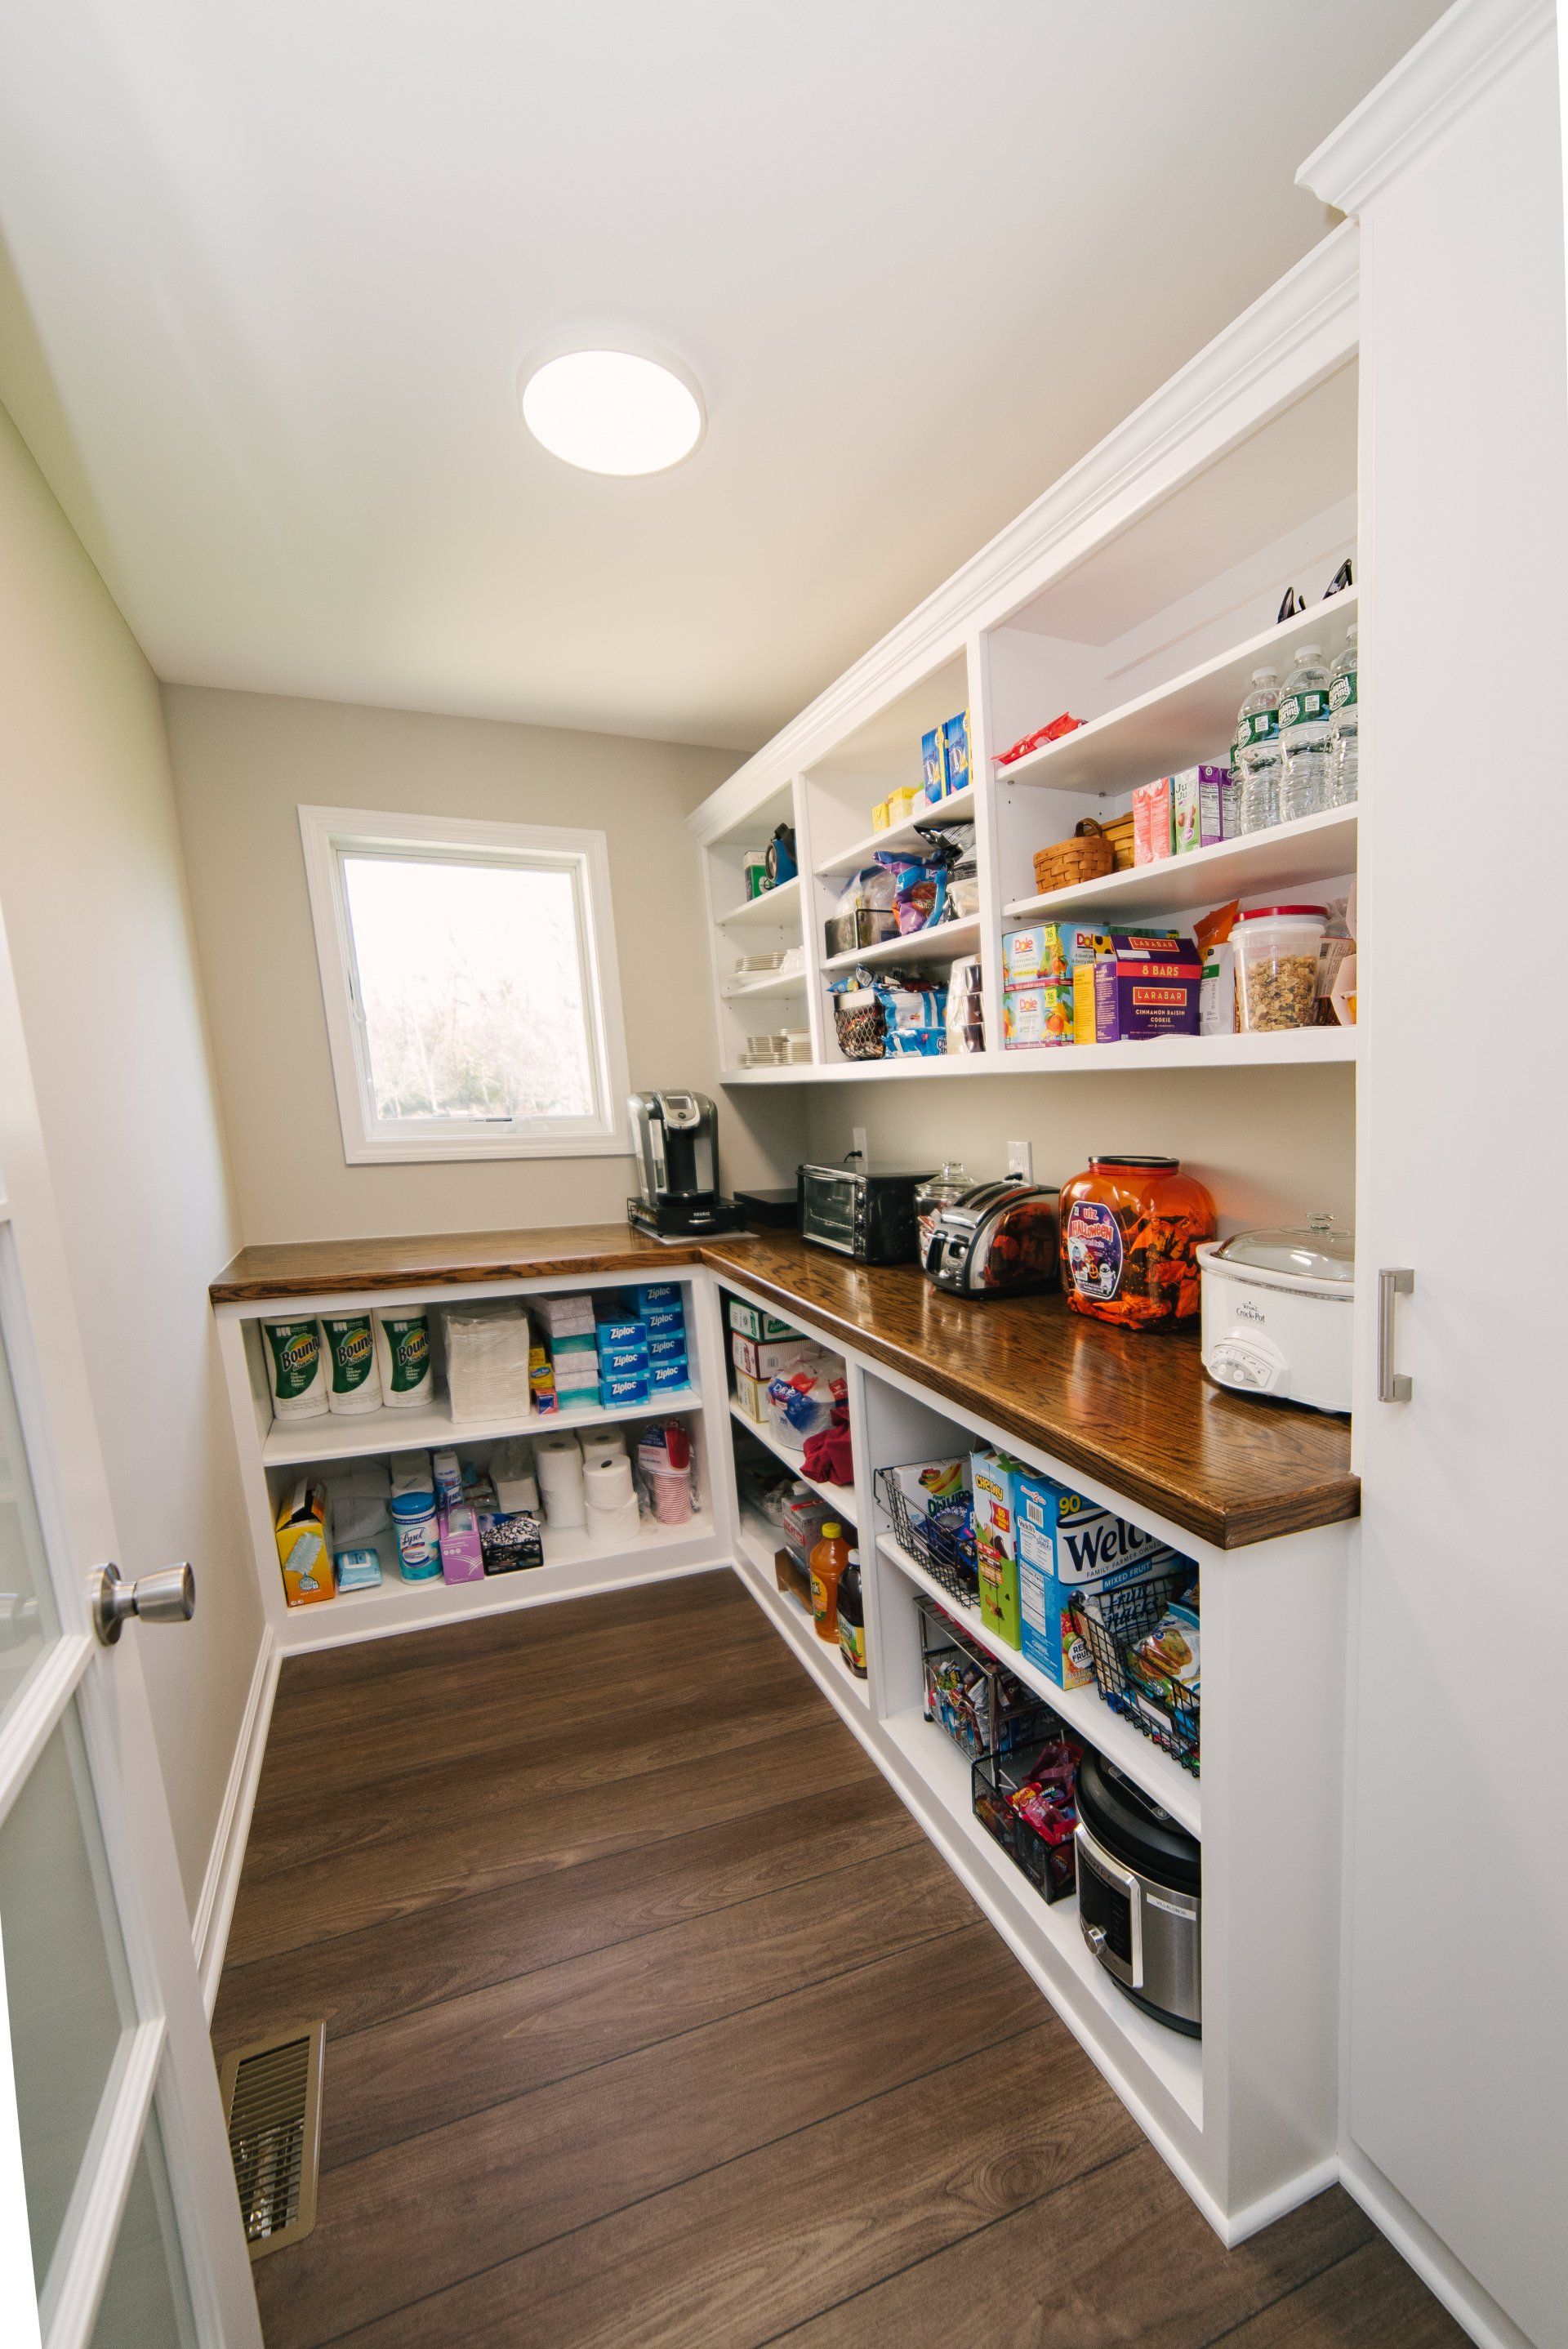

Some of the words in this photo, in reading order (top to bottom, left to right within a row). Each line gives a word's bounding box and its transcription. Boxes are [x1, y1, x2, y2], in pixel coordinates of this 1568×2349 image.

[1014, 937, 1033, 952] Dole
[1076, 933, 1094, 947] Dol
[1143, 965, 1148, 975] 8
[1152, 965, 1178, 976] BARS
[1020, 997, 1037, 1010] Dole
[1138, 992, 1182, 1001] LARABAR
[1071, 1219, 1114, 1242] HALLOWEEN
[648, 1287, 670, 1299] Ziploc
[650, 1314, 674, 1327] Ziploc
[610, 1326, 635, 1339] Ziploc
[280, 1336, 320, 1371] Bounty
[652, 1340, 675, 1353] Ziploc
[613, 1354, 638, 1366] Ziploc
[656, 1366, 679, 1380] Ziploc
[612, 1381, 637, 1395] Ziploc
[1058, 1494, 1081, 1515] 90
[402, 1529, 425, 1547] Lysol
[1086, 1566, 1110, 1578] FAMILY
[1112, 1552, 1138, 1567] FARMER
[1139, 1540, 1160, 1555] OWNED
[1104, 1572, 1128, 1588] MIXED
[1129, 1561, 1151, 1576] FRUIT
